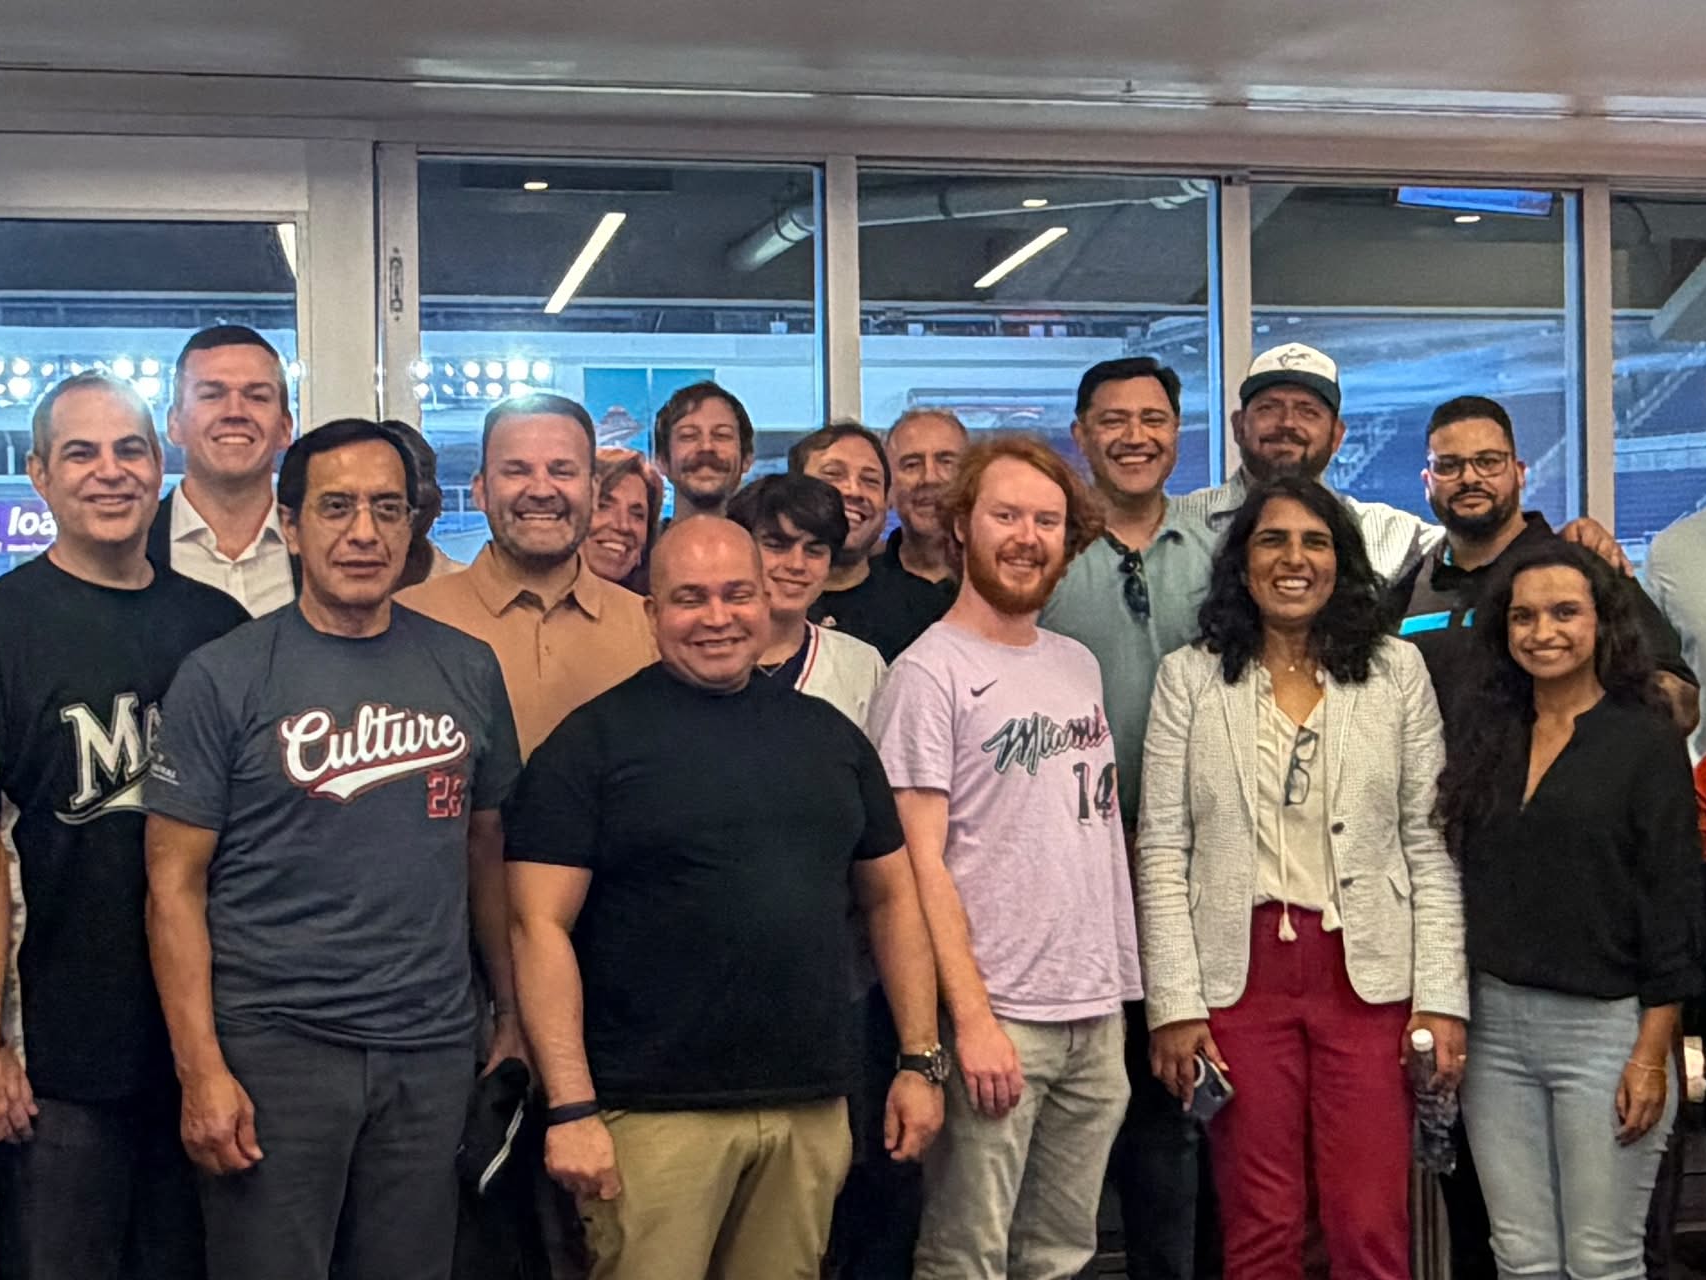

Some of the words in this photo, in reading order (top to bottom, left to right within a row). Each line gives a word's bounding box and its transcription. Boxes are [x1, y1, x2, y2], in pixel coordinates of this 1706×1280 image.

[7, 506, 58, 536] loa
[280, 703, 466, 782] Culture
[981, 703, 1111, 776] Miami
